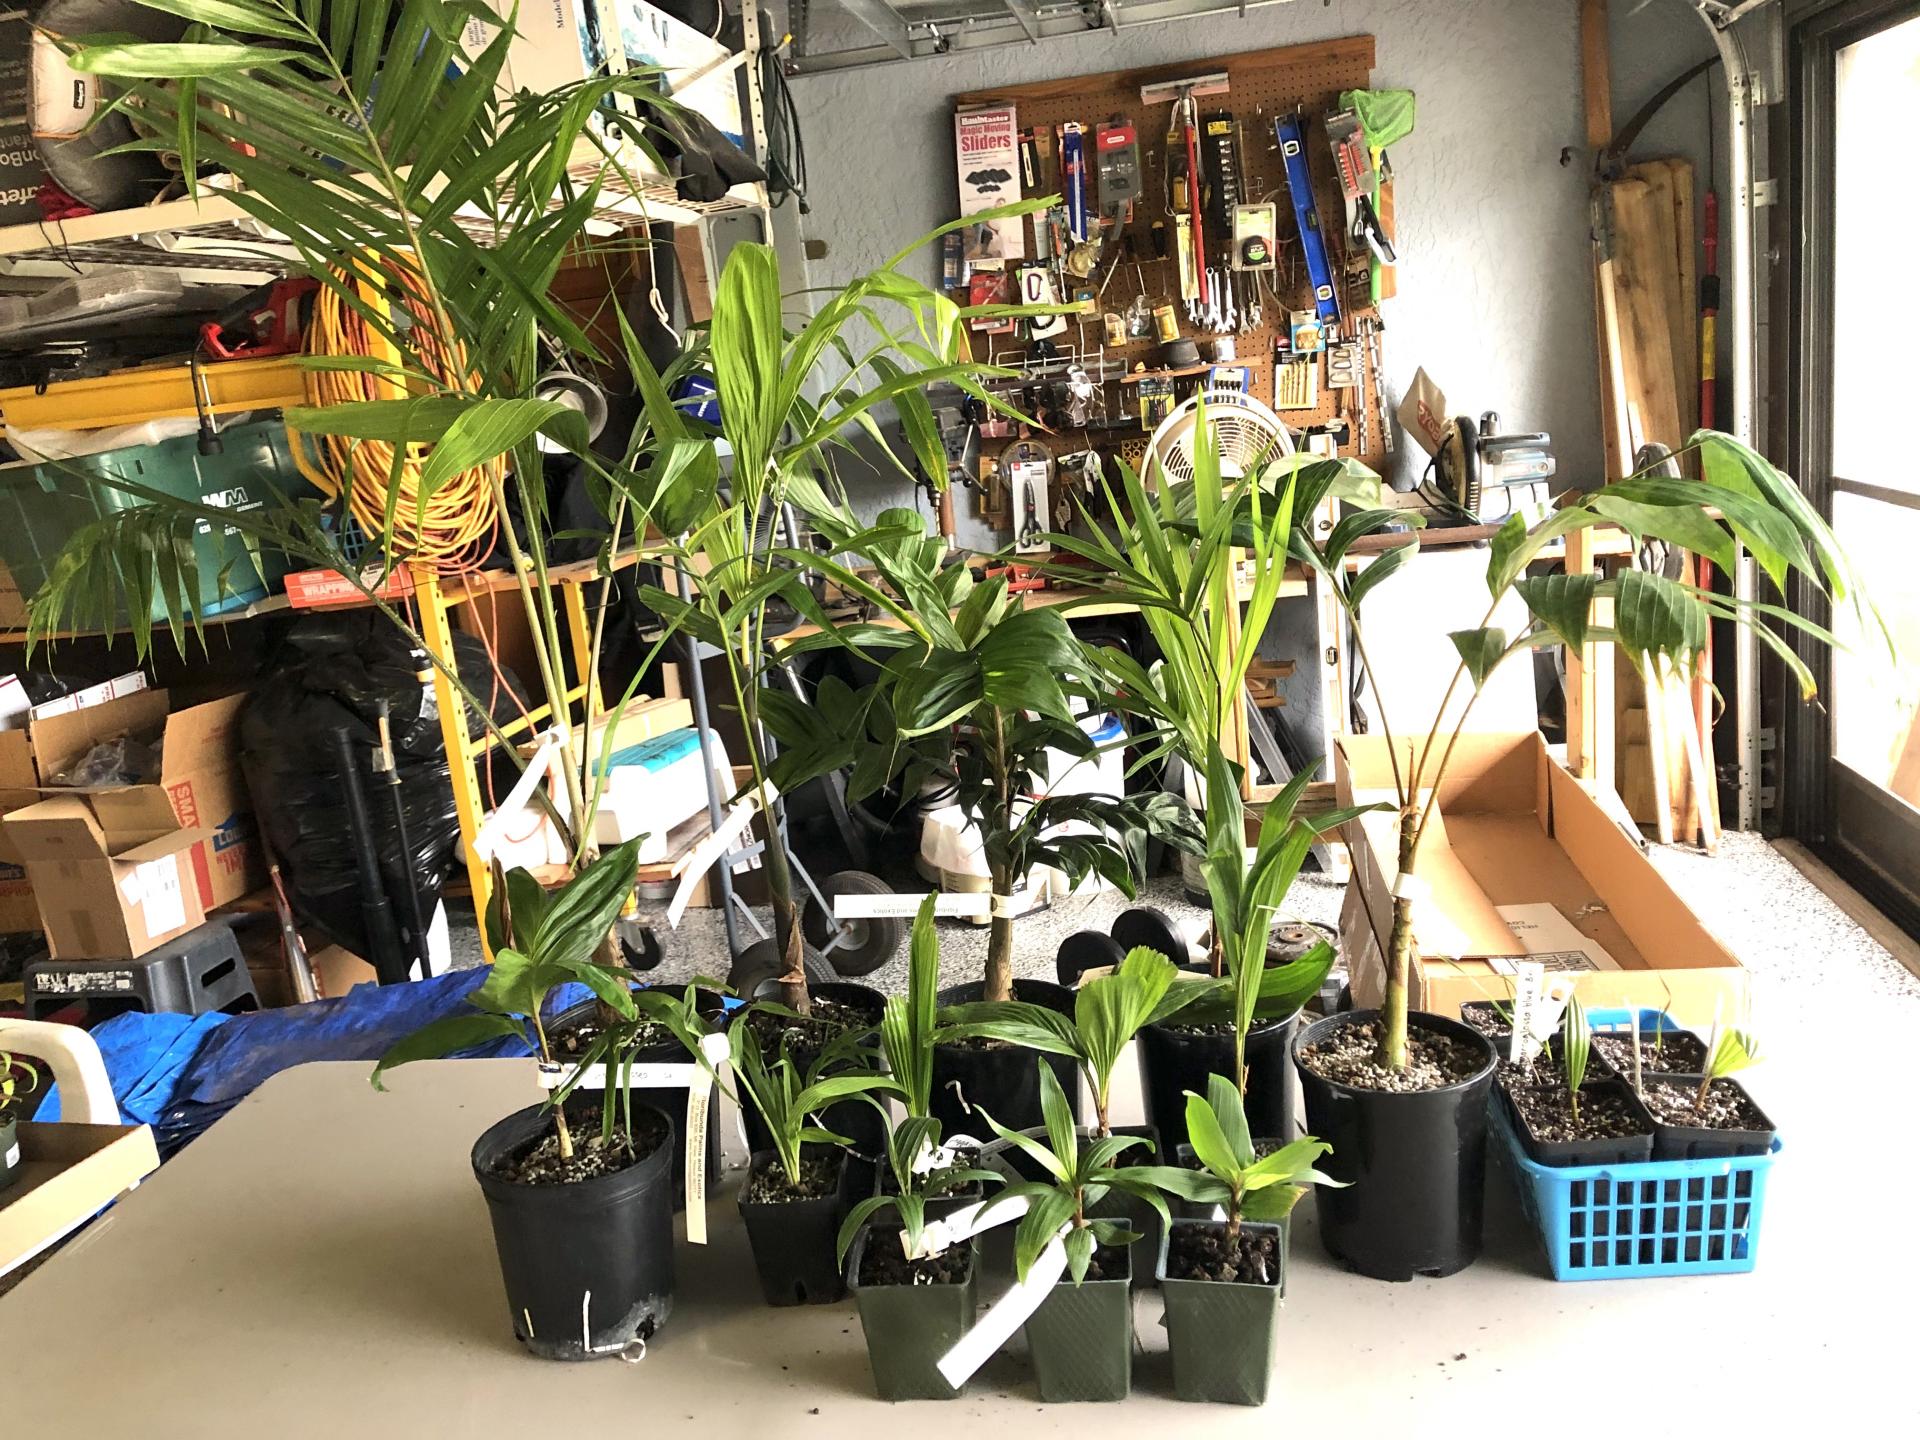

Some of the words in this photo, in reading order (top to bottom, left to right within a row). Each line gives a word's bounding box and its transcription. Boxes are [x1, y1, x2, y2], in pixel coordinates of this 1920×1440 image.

[960, 125, 983, 136] Magic
[983, 122, 1011, 134] Moving
[961, 134, 1011, 152] Sliders
[1418, 403, 1440, 442] RYOB
[202, 487, 249, 508] WM
[302, 581, 356, 597] WRAPPIN
[174, 785, 198, 829] SMA
